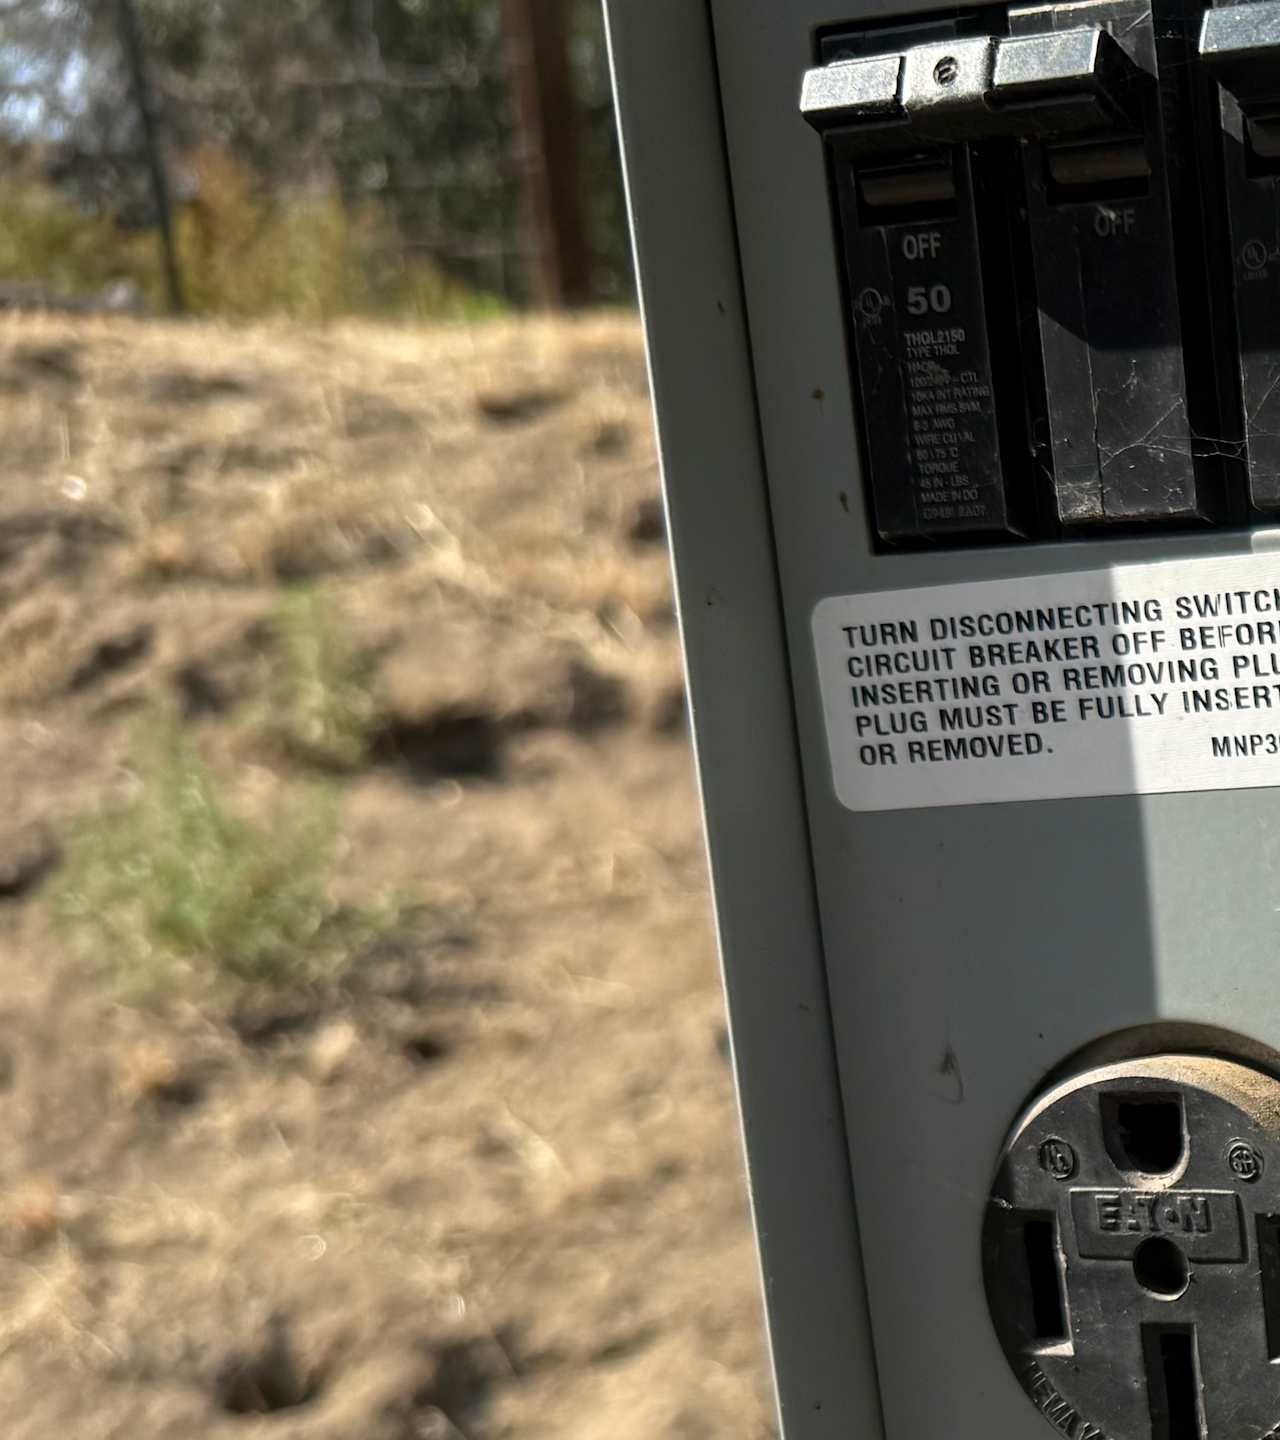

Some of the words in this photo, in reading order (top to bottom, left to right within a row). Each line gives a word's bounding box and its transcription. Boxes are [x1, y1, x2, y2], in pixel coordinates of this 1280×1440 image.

[1094, 209, 1136, 236] OFF
[902, 232, 942, 260] OFF
[906, 283, 952, 316] 50
[843, 620, 919, 649] TURN
[931, 599, 1163, 640] DISCONNECTING
[847, 648, 955, 678] CIRCUIT
[969, 636, 1100, 668] BREAKER
[1111, 629, 1166, 656] OFF
[851, 677, 1000, 707] INSERTING
[1012, 670, 1050, 696] OR
[1064, 657, 1219, 691] REMOVING
[856, 708, 928, 737] PLUG
[939, 703, 1017, 731] MUST
[1032, 698, 1067, 724] BE
[1079, 692, 1169, 721] FULLY
[859, 741, 897, 766] OR
[908, 732, 1054, 763] REMOVED.
